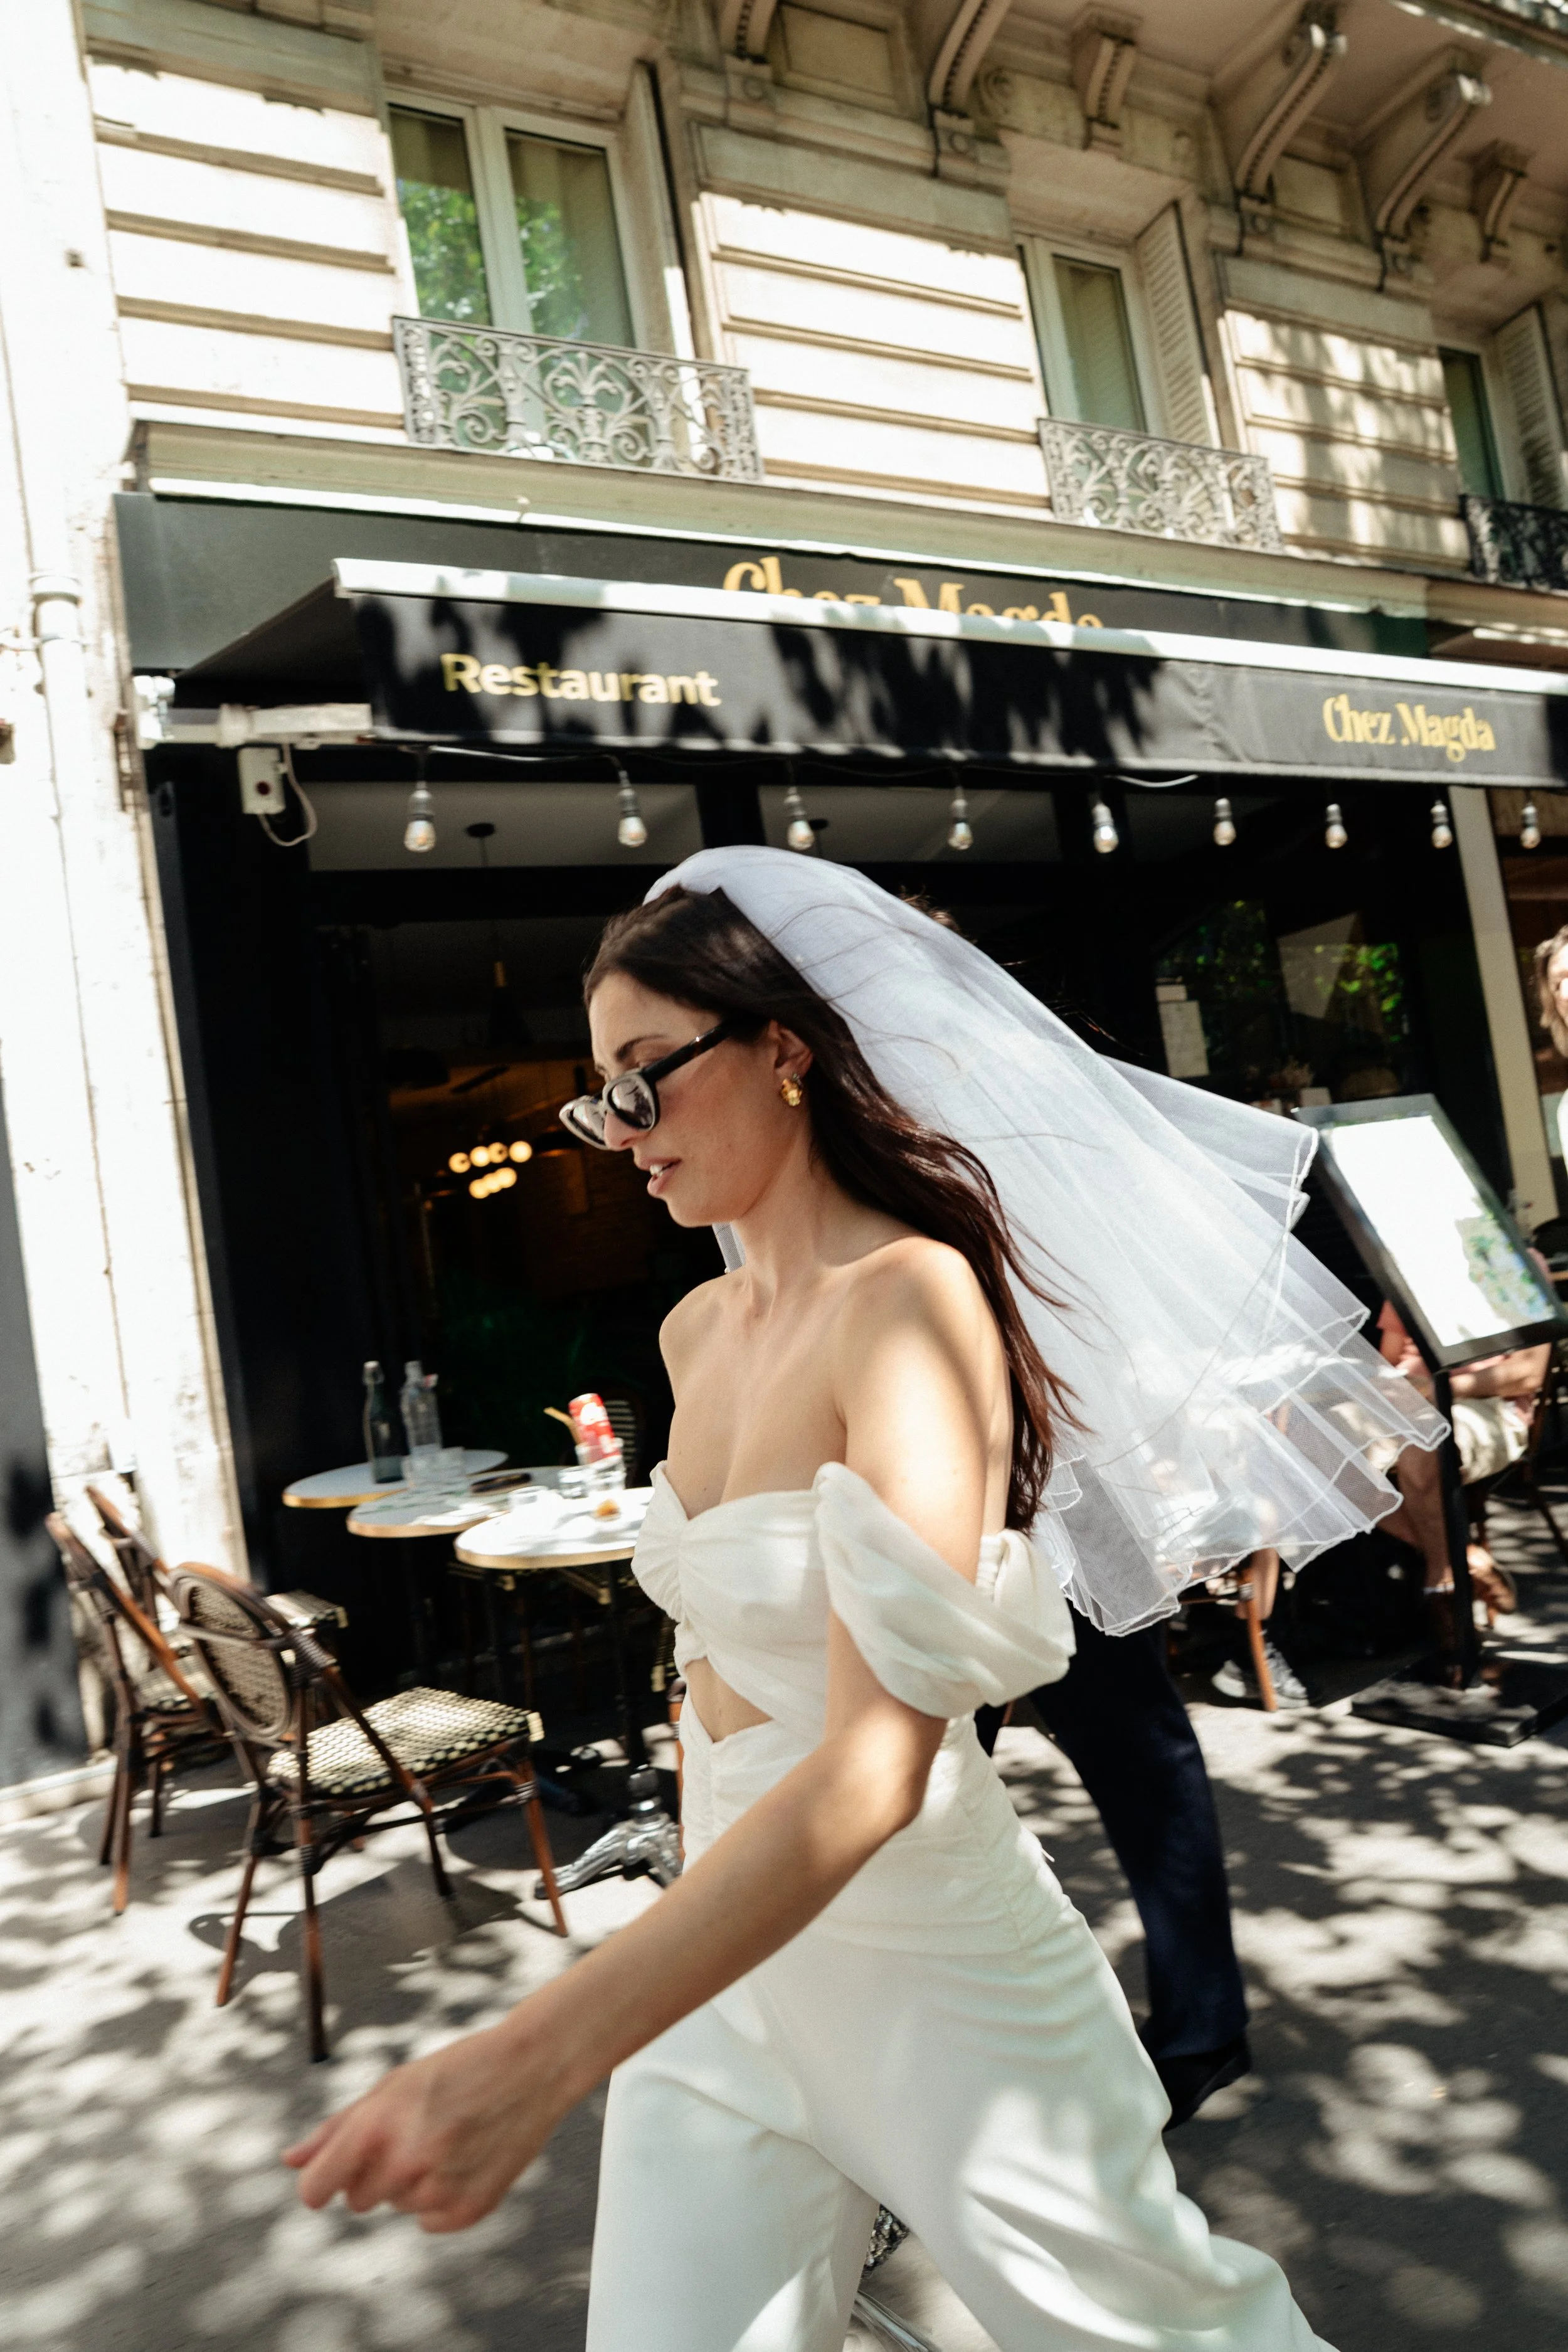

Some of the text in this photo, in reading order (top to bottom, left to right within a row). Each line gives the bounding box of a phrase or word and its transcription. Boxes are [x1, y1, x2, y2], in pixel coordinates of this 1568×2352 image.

[440, 653, 722, 707] Restaurant
[1322, 693, 1496, 763] Chez Magda
